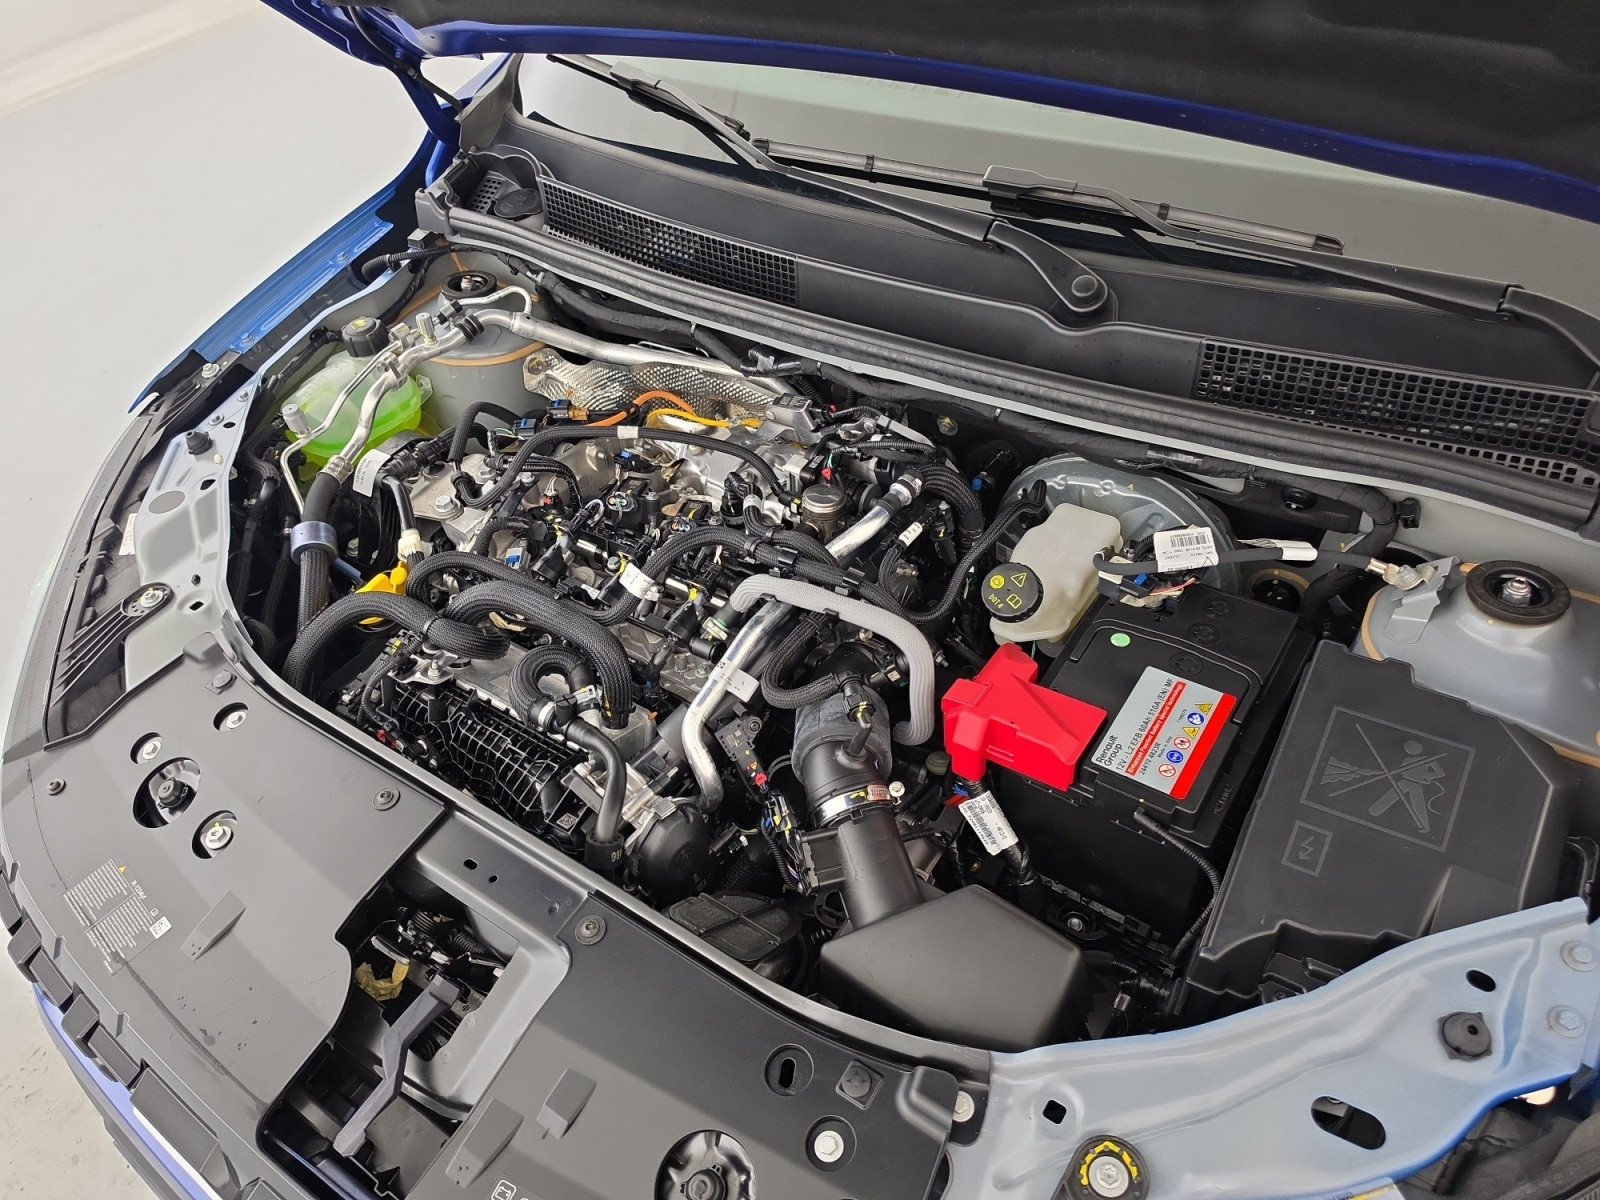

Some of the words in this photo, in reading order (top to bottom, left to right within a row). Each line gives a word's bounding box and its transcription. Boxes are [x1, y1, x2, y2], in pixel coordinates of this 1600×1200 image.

[1096, 735, 1118, 763] Renault
[1115, 758, 1127, 771] 12V
[1130, 731, 1142, 746] EFB
[1138, 715, 1152, 733] 60Ah
[1148, 699, 1161, 716] 510A
[1157, 687, 1169, 701] (EN)
[1127, 750, 1143, 773] Enhanced
[1139, 734, 1153, 752] Flooded
[1149, 718, 1163, 736] Battery
[1104, 743, 1123, 766] Group
